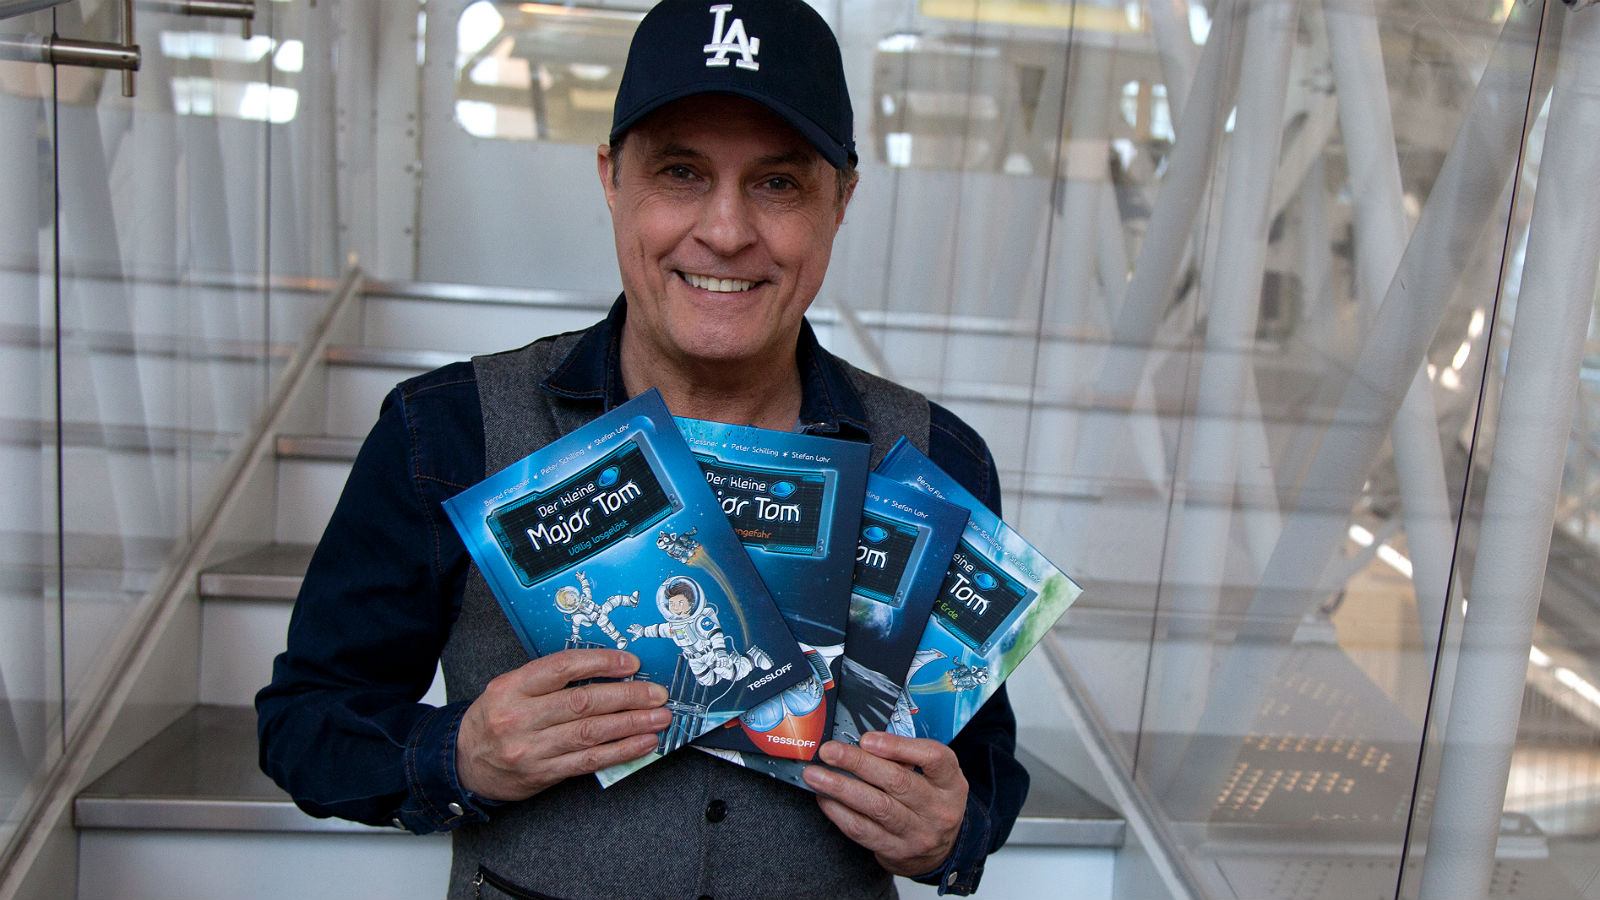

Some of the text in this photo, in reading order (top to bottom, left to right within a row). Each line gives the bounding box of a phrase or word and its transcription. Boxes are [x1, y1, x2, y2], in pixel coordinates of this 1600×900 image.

[703, 3, 760, 71] LA
[484, 422, 630, 507] Bernd Flessner Peter Schilling Stefan Lohr
[689, 437, 831, 463] Flessner Peter Schilling Stefan Lohr
[537, 482, 596, 518] Der kleine
[706, 472, 766, 492] Der kleine
[917, 475, 935, 492] Bernd
[527, 479, 642, 550] Major Tom
[754, 497, 800, 522] Tom
[891, 500, 913, 513] Stefan
[914, 509, 929, 519] Lohr
[568, 519, 630, 556] Völlig losgelöst
[980, 530, 1002, 551] Schilling
[1009, 556, 1029, 574] Stefan
[1027, 570, 1041, 584] Lohr
[940, 601, 959, 620] Erde
[950, 573, 989, 615] Tom
